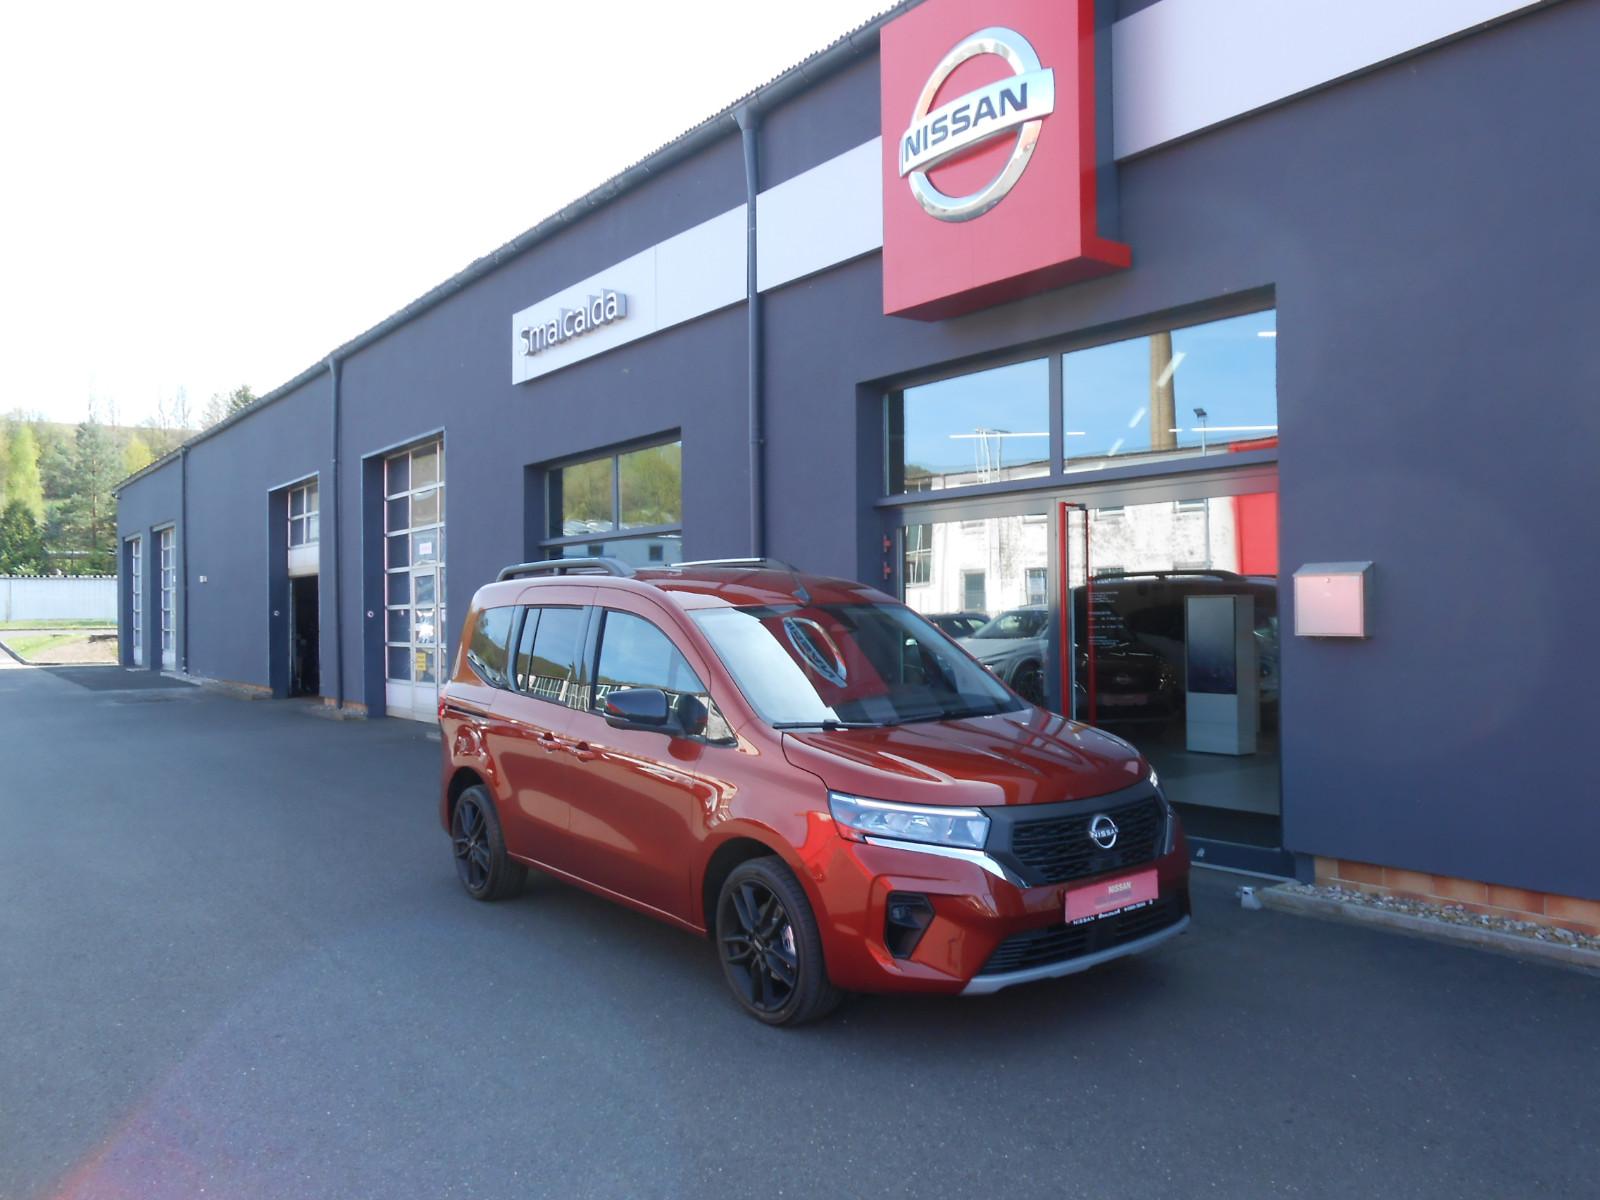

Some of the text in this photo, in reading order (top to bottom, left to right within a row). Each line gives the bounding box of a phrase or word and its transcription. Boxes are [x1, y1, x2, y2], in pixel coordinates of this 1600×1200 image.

[904, 82, 1028, 162] NISSAN
[519, 288, 627, 357] Smalcalda
[1092, 828, 1118, 838] NISSAN
[1108, 881, 1132, 894] NISSAN
